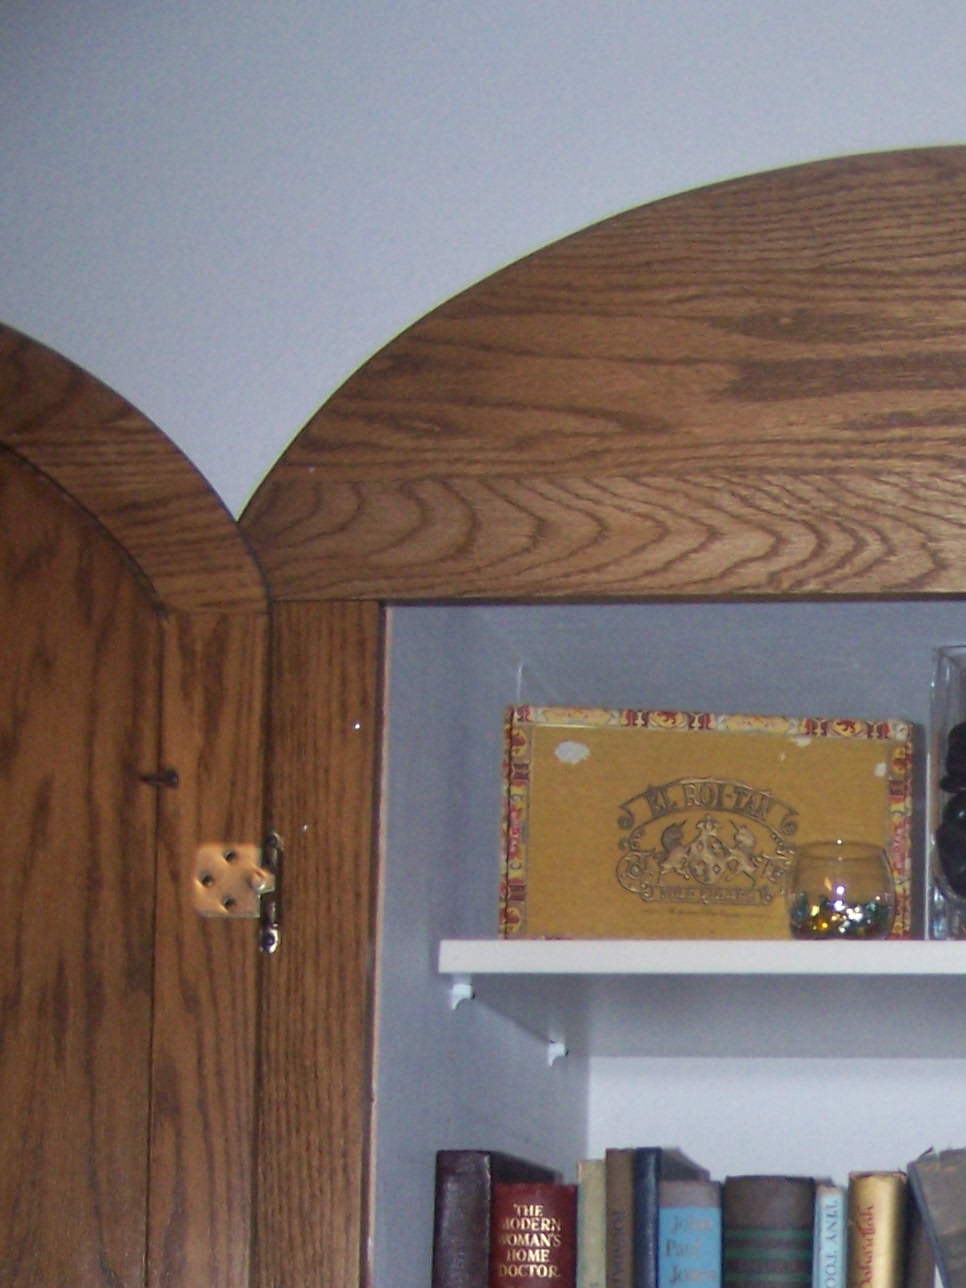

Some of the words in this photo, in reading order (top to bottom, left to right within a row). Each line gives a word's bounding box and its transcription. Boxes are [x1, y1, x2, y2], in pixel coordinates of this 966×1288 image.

[513, 1203, 545, 1218] THE
[501, 1216, 562, 1232] MODERN
[824, 1199, 839, 1245] TINY
[499, 1232, 563, 1248] WOMAN'S
[506, 1248, 551, 1263] HOME
[499, 1263, 562, 1279] DOCTOR
